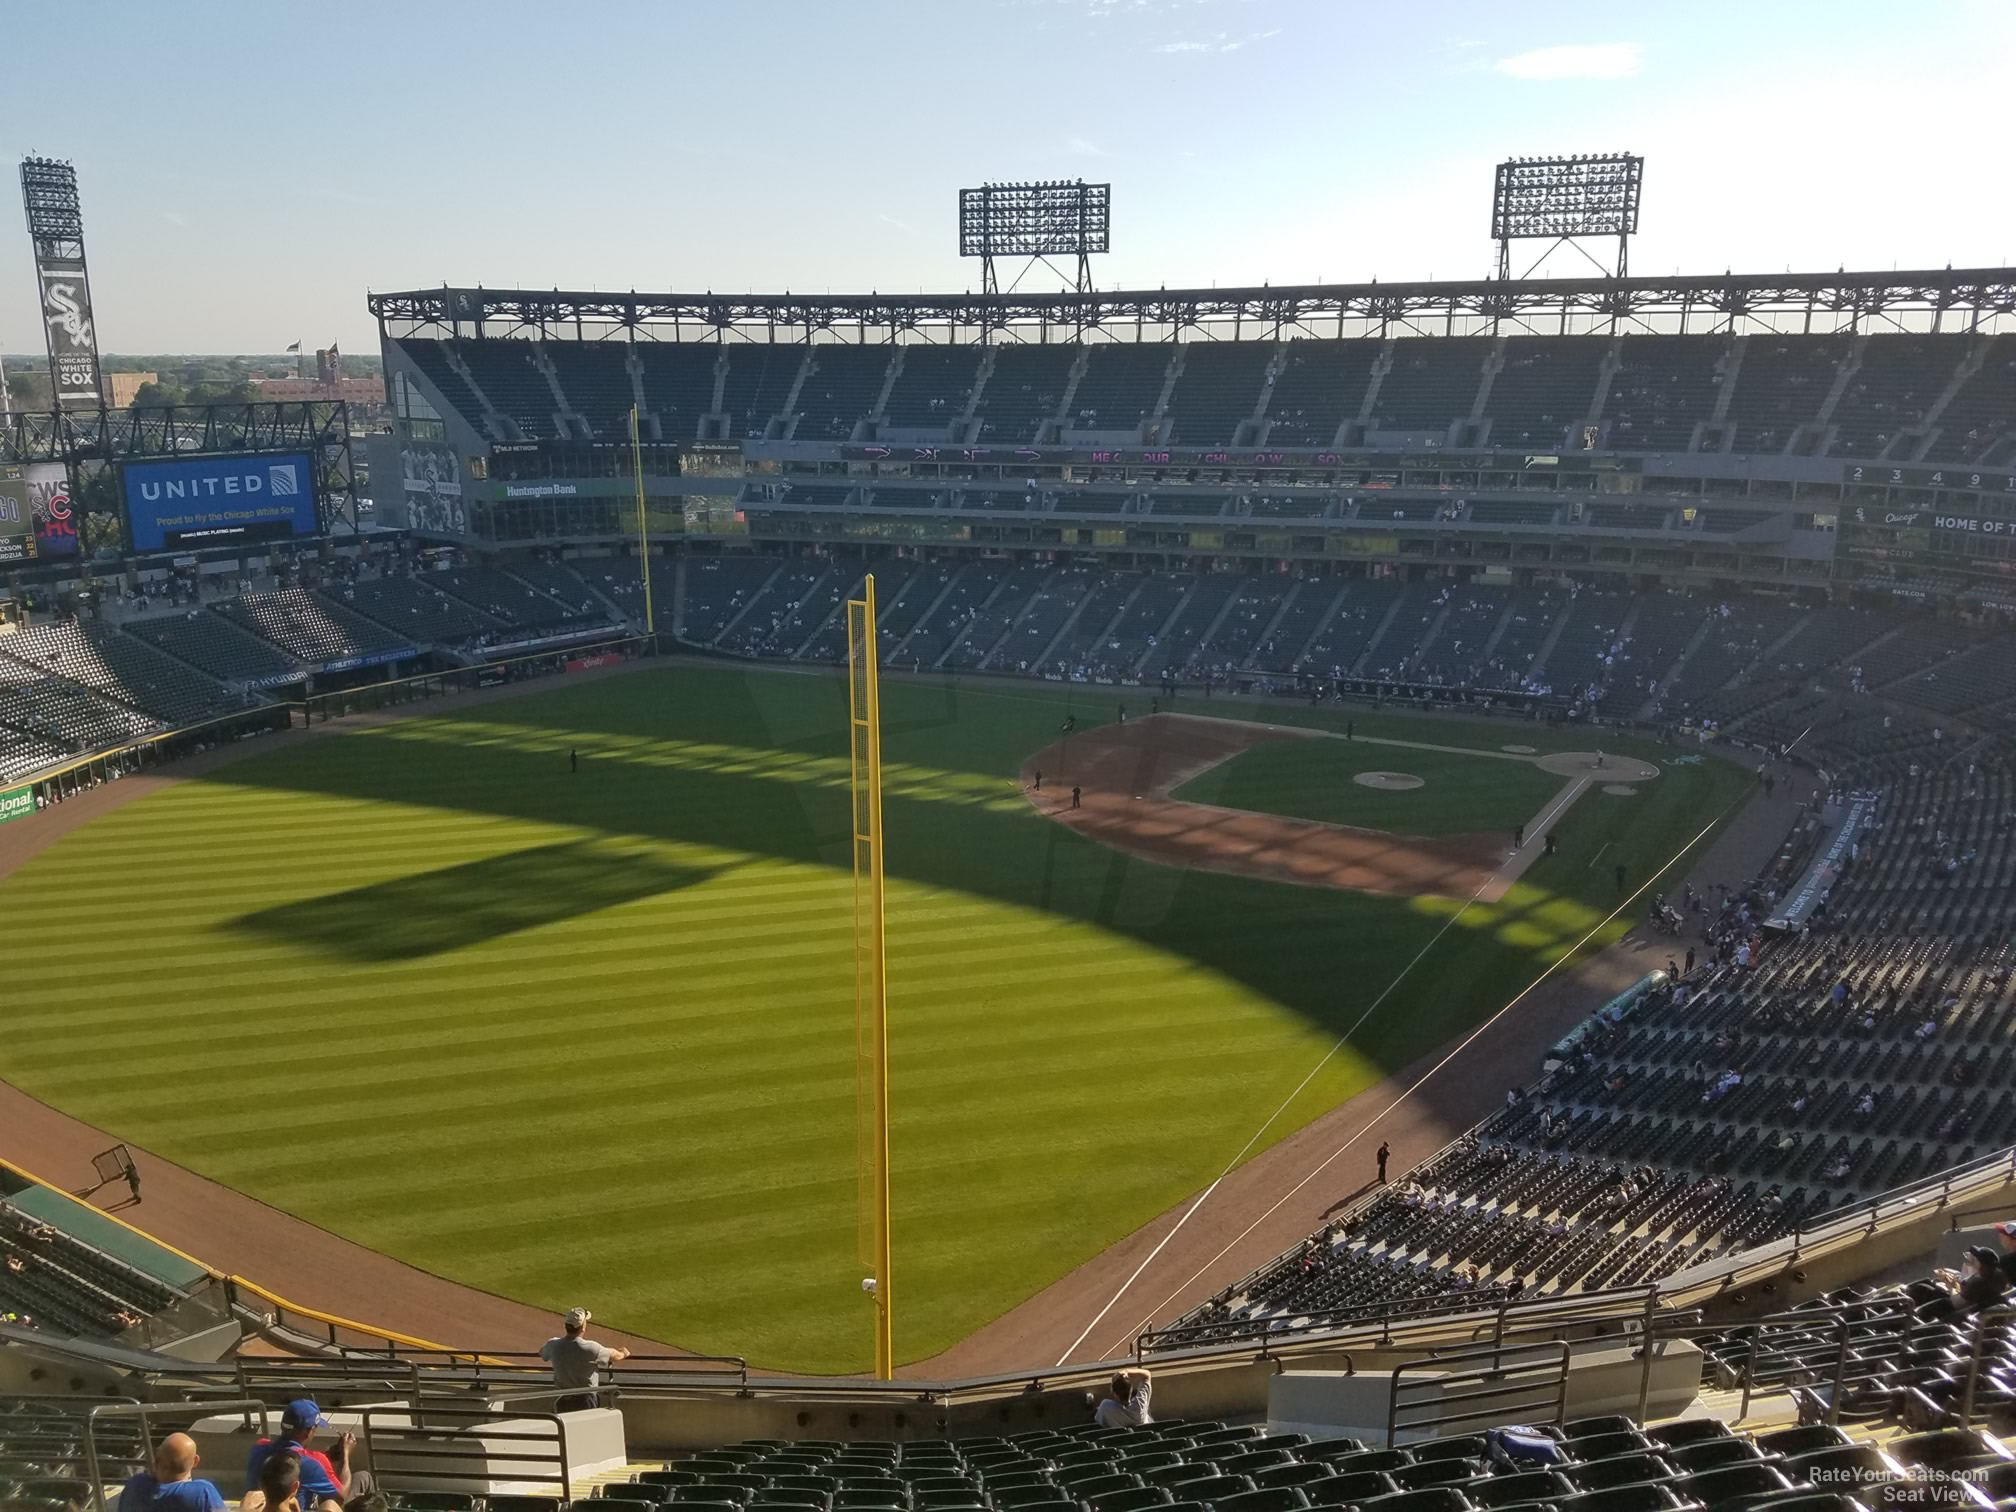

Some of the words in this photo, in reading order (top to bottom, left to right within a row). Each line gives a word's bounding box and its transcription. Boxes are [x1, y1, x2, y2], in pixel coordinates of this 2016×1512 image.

[60, 364, 92, 372] WHITE
[61, 373, 94, 385] SOX
[1854, 467, 1863, 477] 2
[1893, 469, 1902, 480] 3
[1932, 472, 1942, 482] 4
[1971, 474, 1980, 485] 9
[141, 475, 263, 501] UNITED
[507, 486, 553, 498] Huntington
[554, 484, 577, 494] Bank
[156, 516, 184, 526] Proud
[184, 515, 193, 524] to
[195, 513, 206, 524] fly
[208, 512, 222, 521] the
[223, 510, 255, 521] Chicago
[256, 507, 279, 516] White
[280, 506, 295, 514] Sox
[1885, 512, 1919, 525] Chicago
[1935, 516, 1978, 531] HOME
[1982, 521, 2004, 533] OF
[1889, 549, 1914, 558] CLUB
[1892, 589, 1926, 598] RATE.COM
[326, 658, 363, 671] ATHLETICO
[366, 655, 380, 664] THE
[380, 650, 416, 661] RELIEVERS
[583, 656, 604, 668] xfinity
[259, 671, 308, 686] HYUNDAI
[1095, 676, 1113, 684] Modelo
[1121, 678, 1140, 686] Modelo
[11, 804, 30, 816] Rental
[1784, 893, 1810, 917] WELCOME
